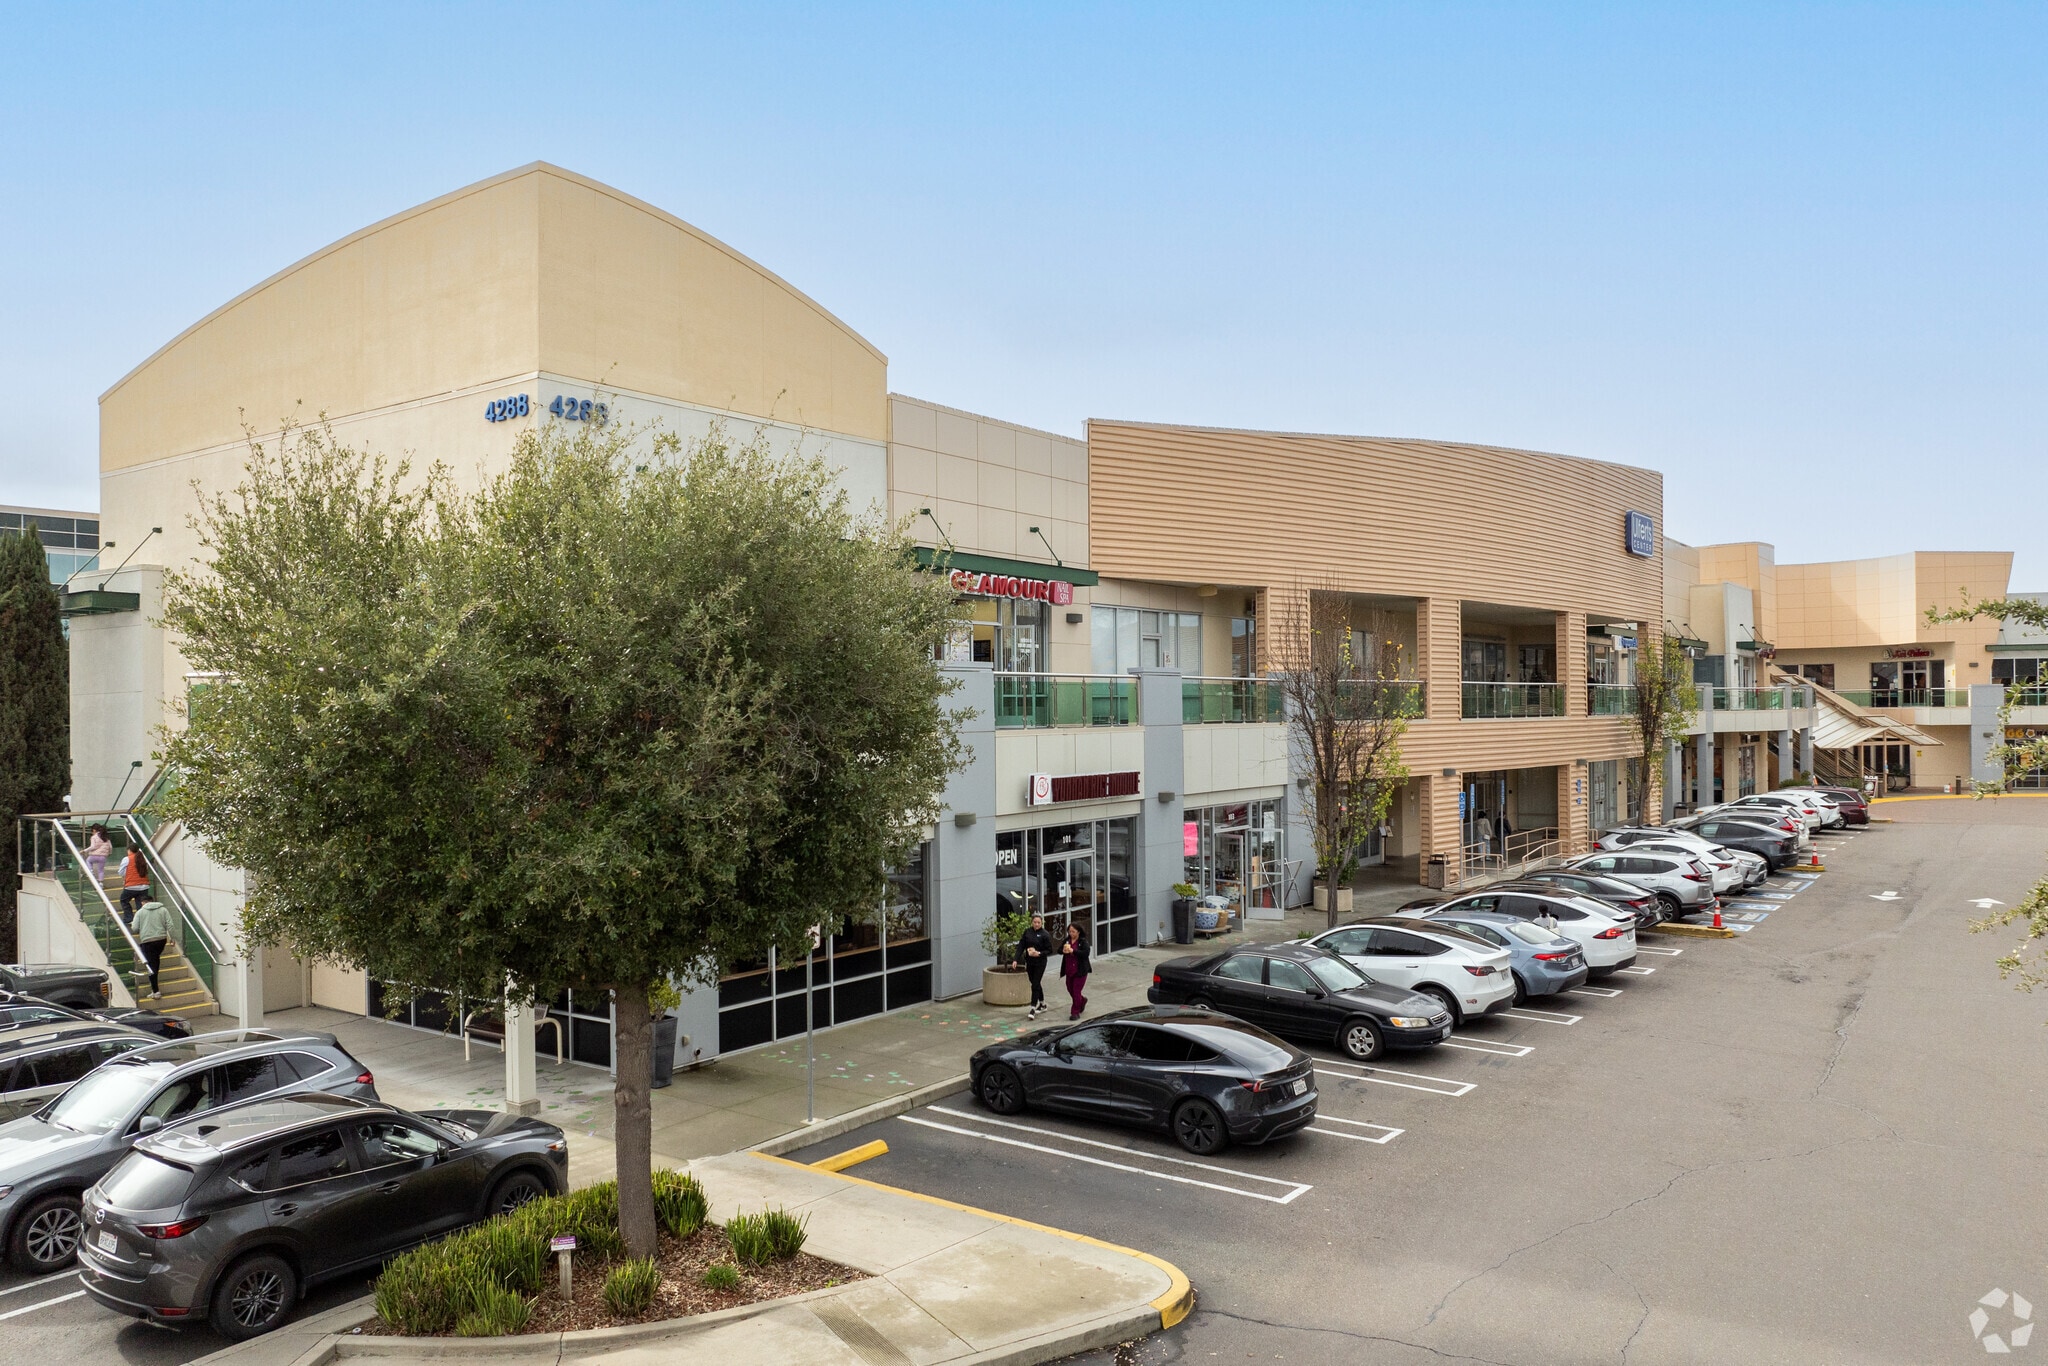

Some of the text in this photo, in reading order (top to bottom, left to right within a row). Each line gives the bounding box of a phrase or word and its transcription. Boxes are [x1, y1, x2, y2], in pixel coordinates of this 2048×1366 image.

[485, 393, 529, 423] 4288
[1633, 540, 1652, 552] CENTER
[950, 570, 1049, 601] GLAMOUR
[1056, 583, 1070, 594] NAIL
[1059, 593, 1071, 604] SPA
